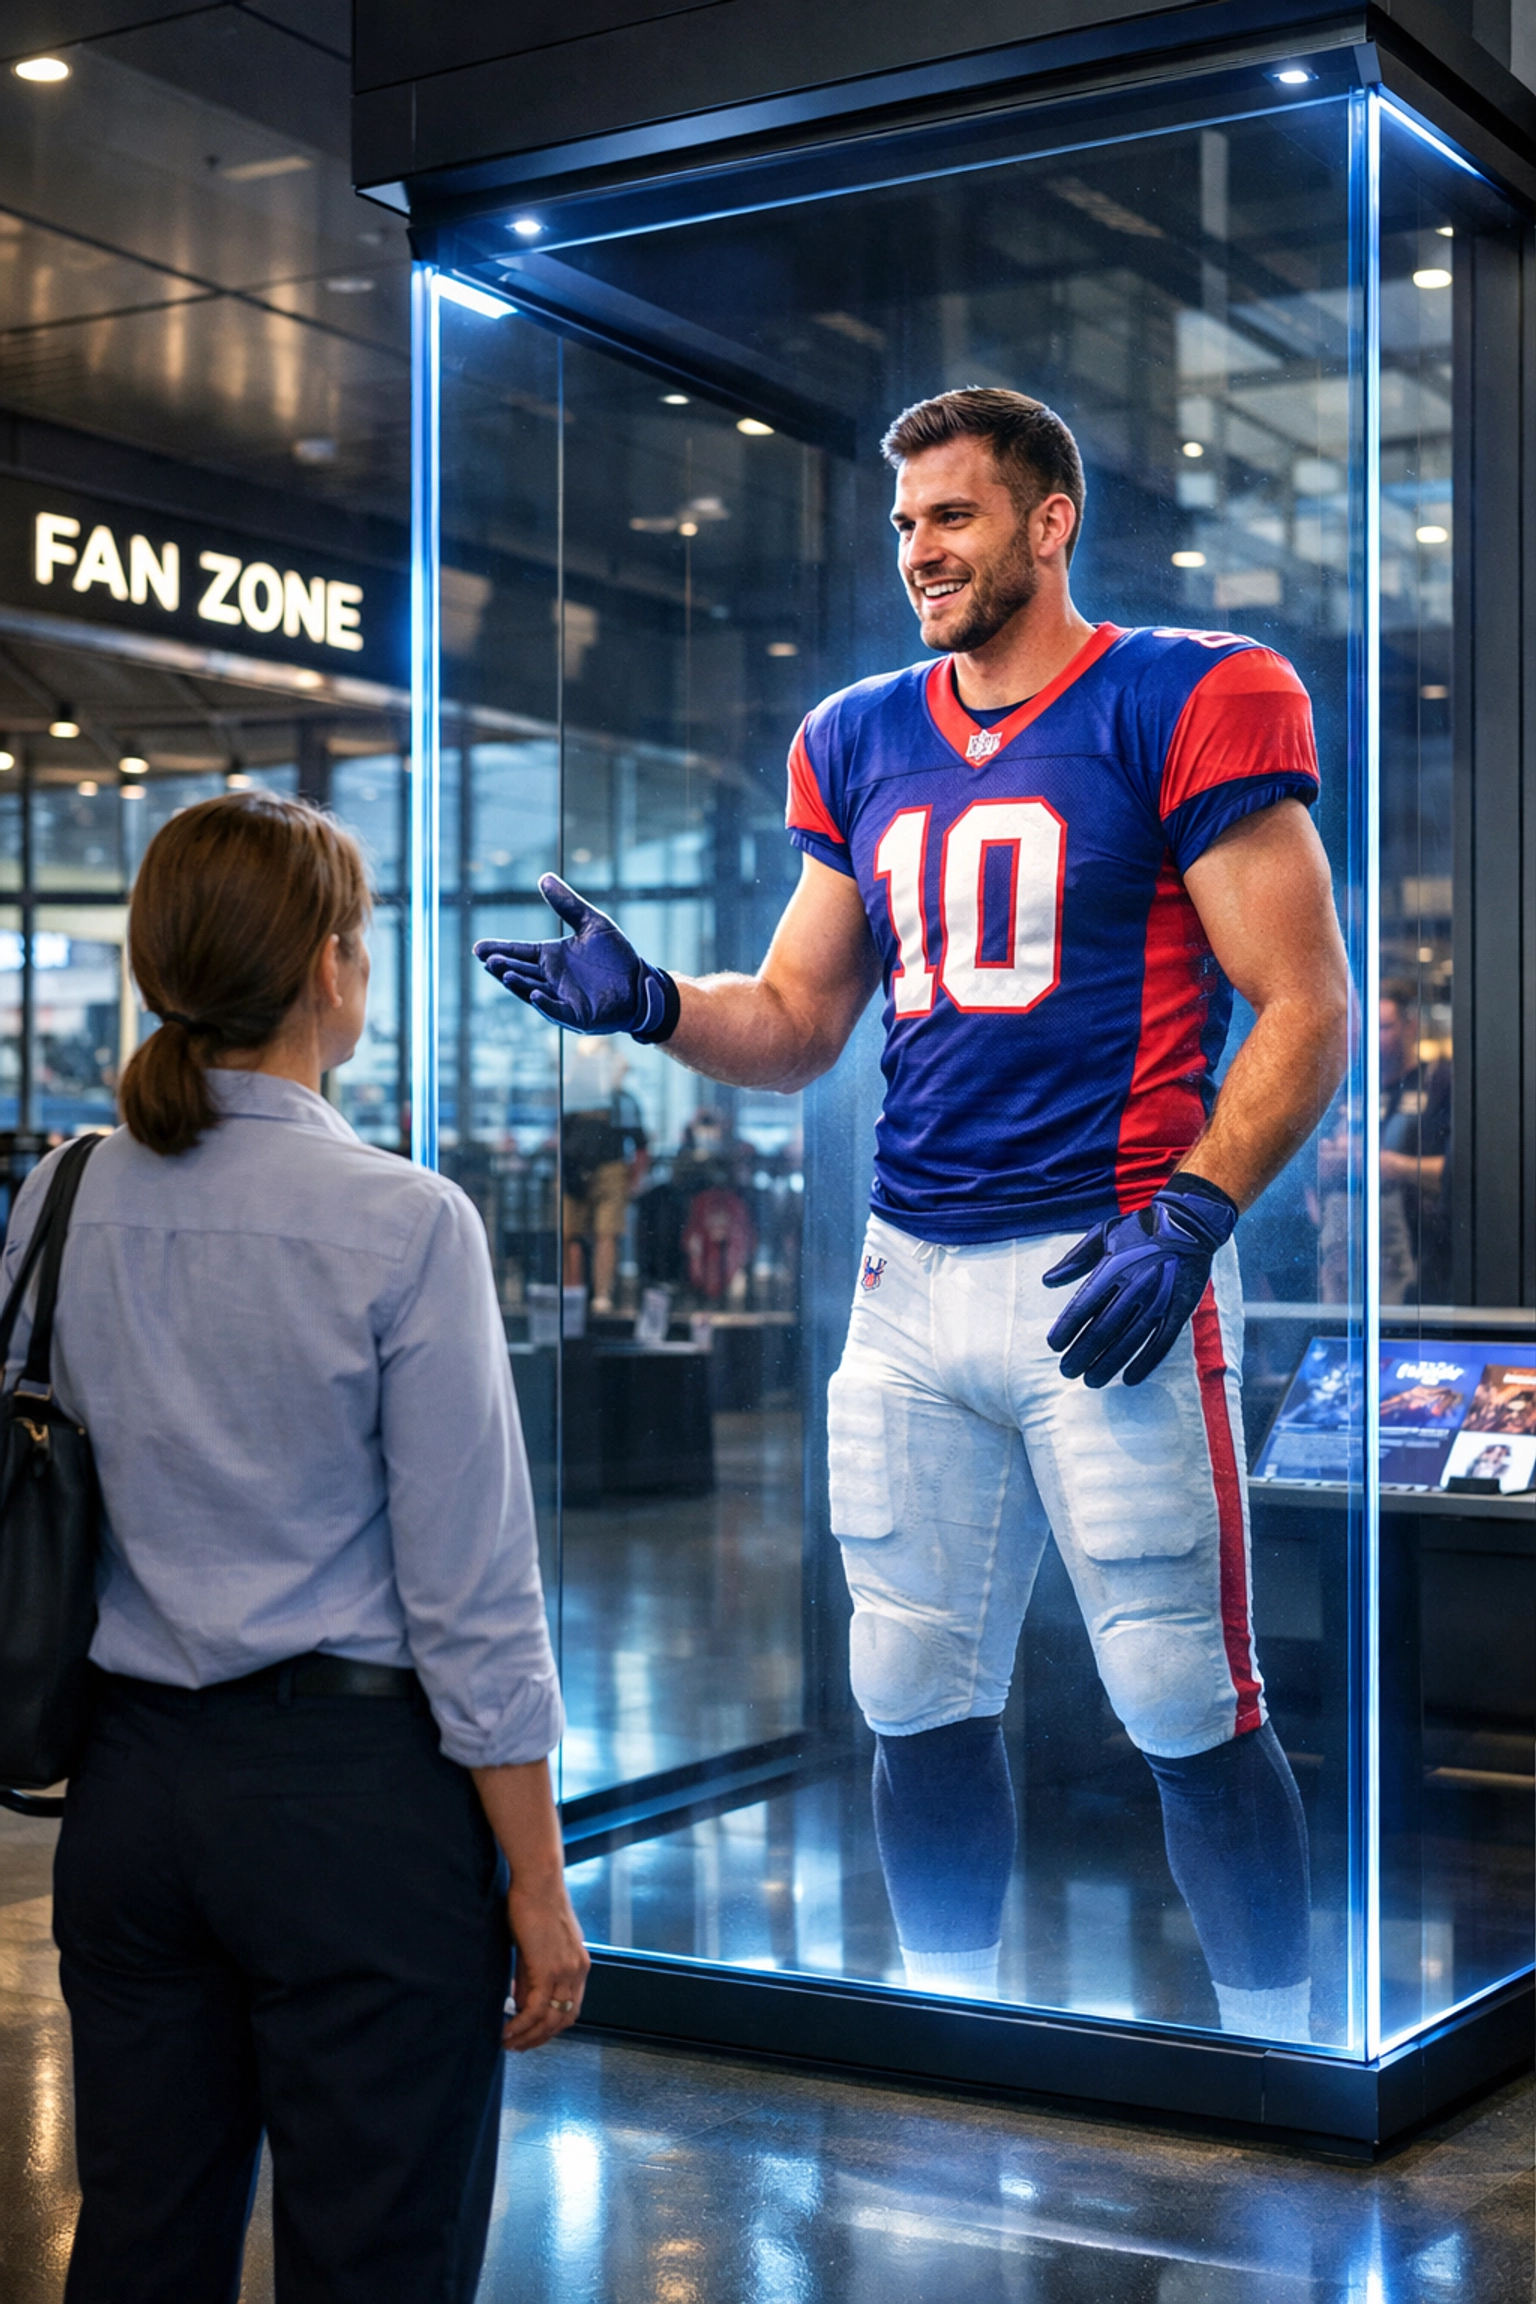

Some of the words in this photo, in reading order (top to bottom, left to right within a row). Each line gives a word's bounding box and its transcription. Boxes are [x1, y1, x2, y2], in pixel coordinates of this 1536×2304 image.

[36, 512, 180, 612] FAN
[198, 551, 364, 652] ZONE
[874, 796, 1068, 1021] 10
